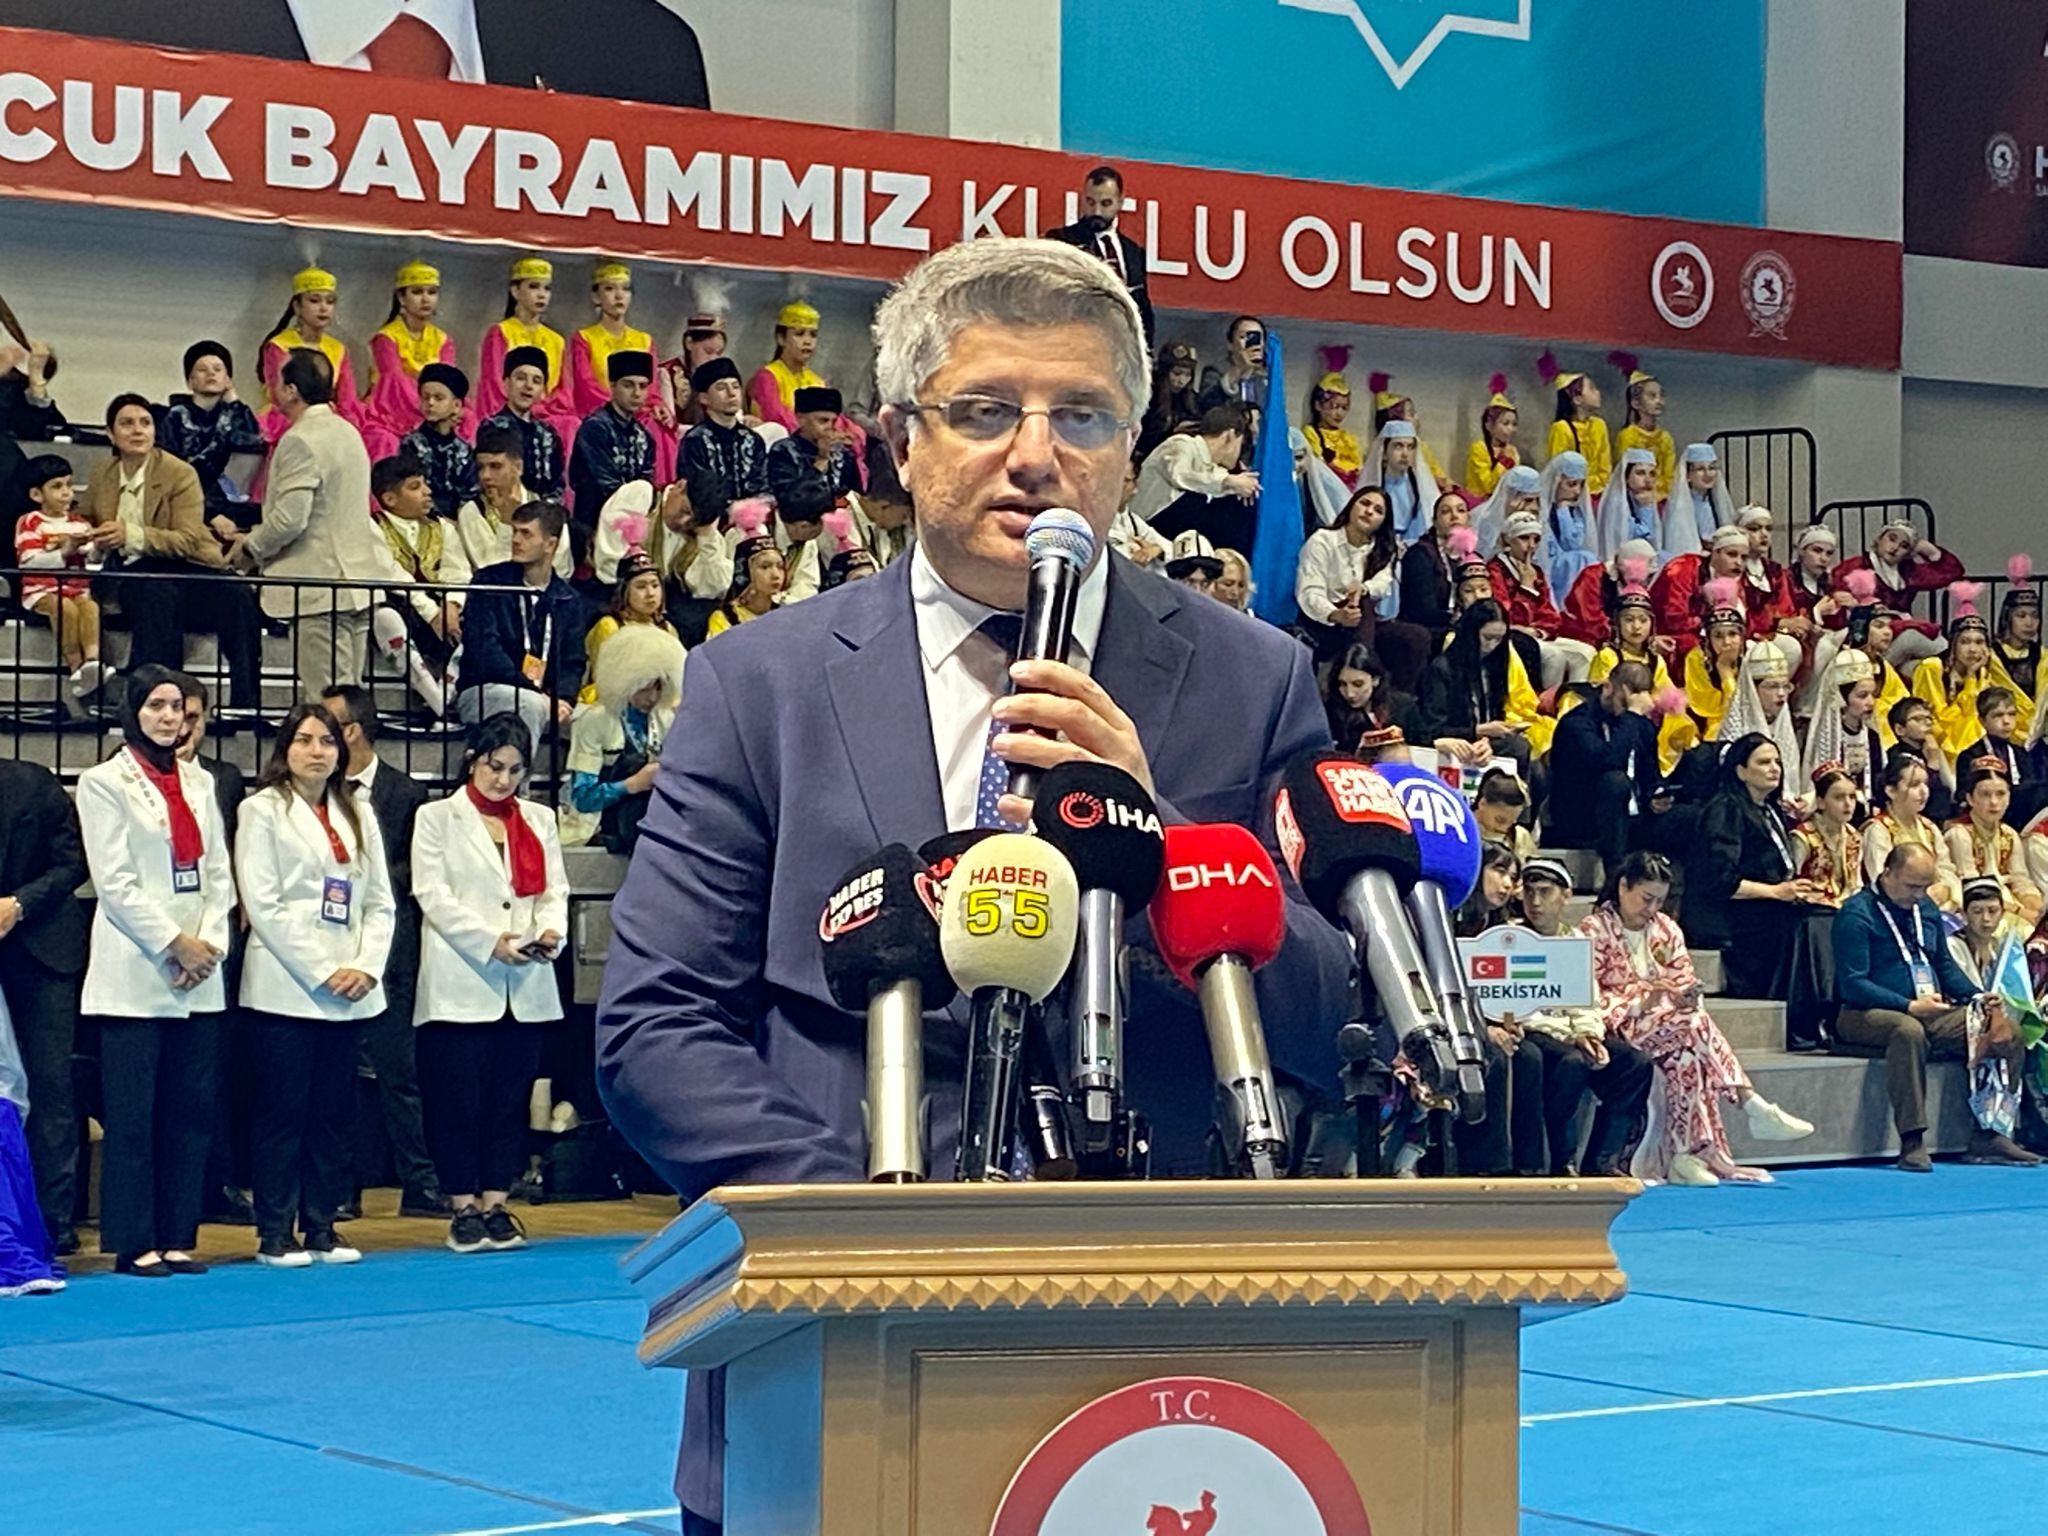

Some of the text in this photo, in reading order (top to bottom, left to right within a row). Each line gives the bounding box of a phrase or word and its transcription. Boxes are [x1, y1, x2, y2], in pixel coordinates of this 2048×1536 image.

[265, 103, 931, 252] BAYRAMIMIZ
[1280, 216, 1551, 310] OLSUN
[968, 866, 1048, 889] HABER
[1168, 861, 1274, 891] DHA
[966, 888, 1050, 939] 55
[1150, 1389, 1217, 1422] T.C.
